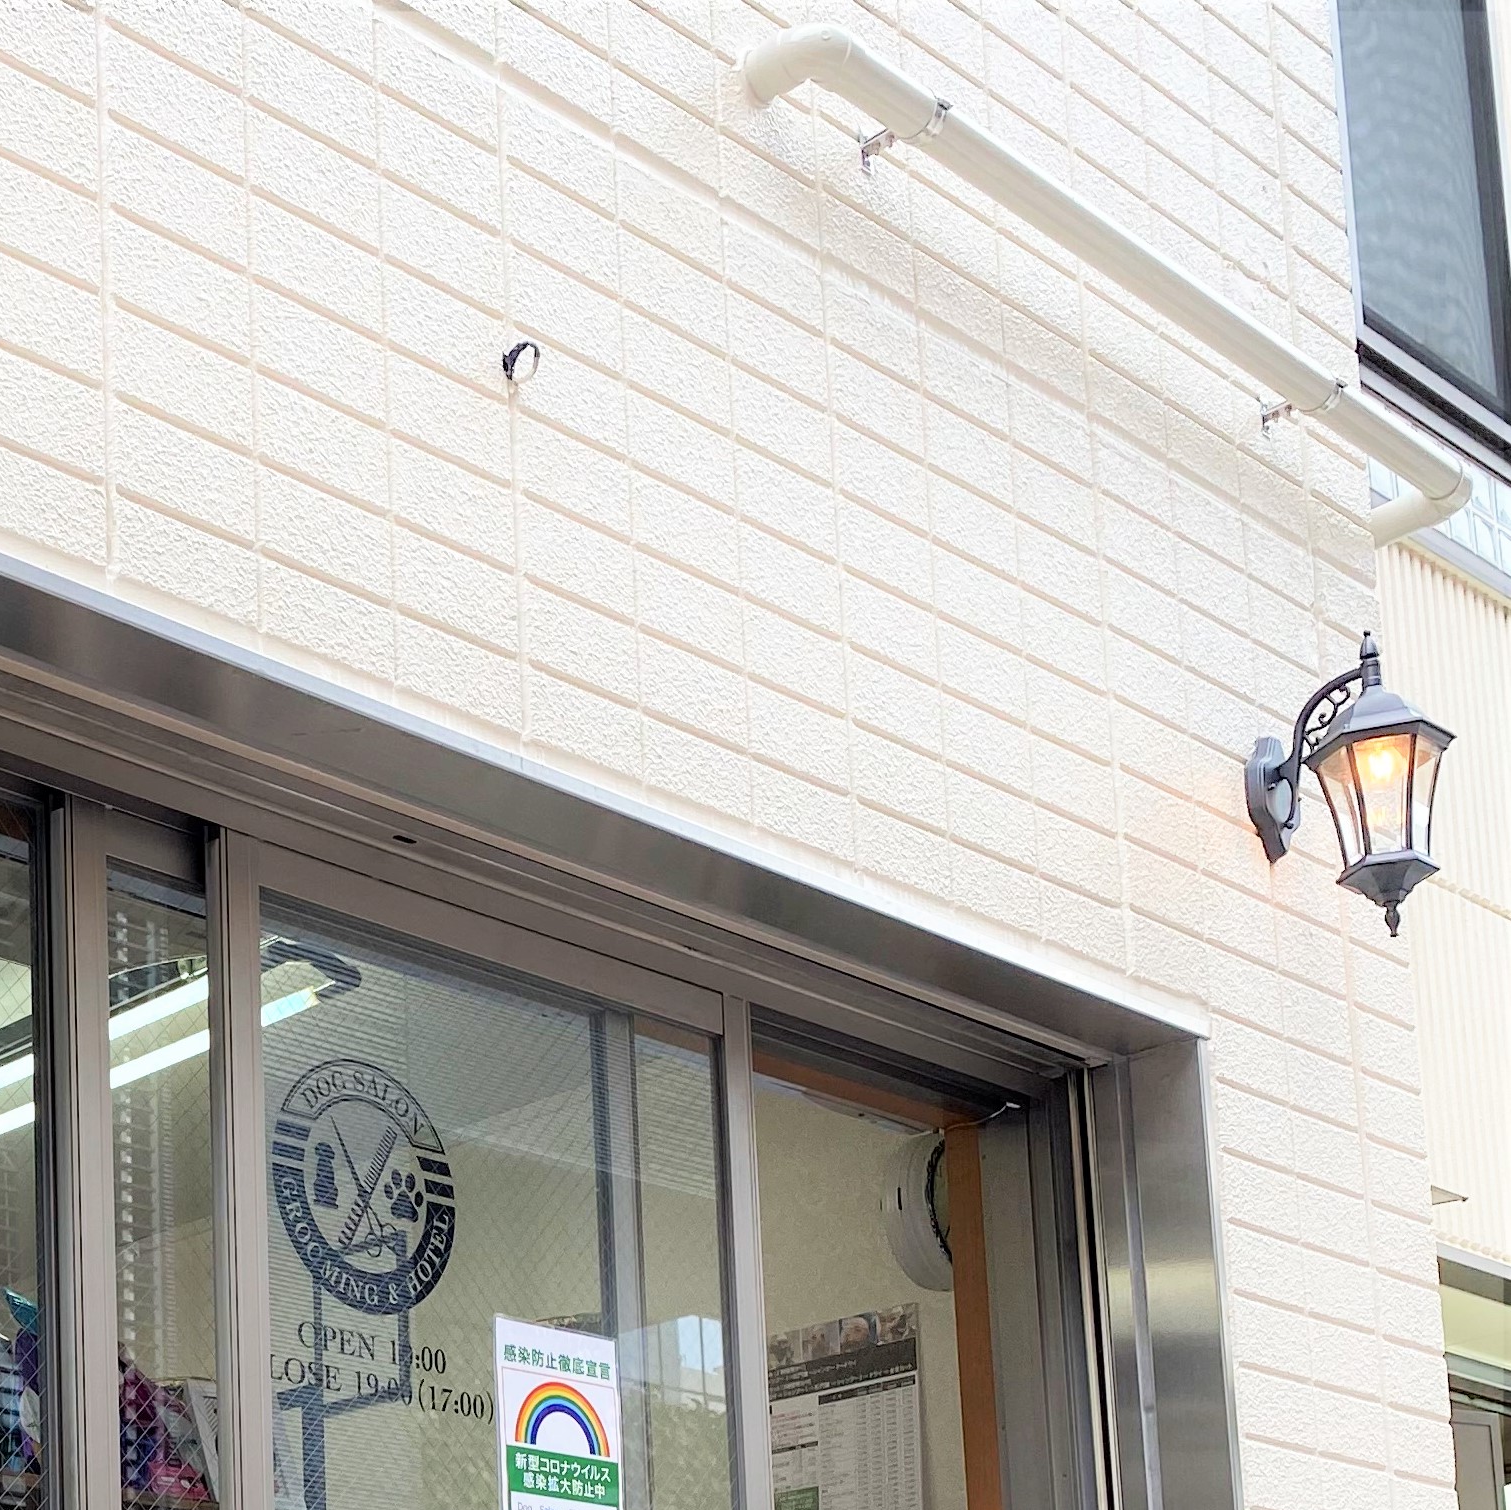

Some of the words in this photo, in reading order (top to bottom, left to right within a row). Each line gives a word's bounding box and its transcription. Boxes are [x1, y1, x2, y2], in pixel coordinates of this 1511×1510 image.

[299, 1072, 347, 1109] DOG
[353, 1070, 425, 1135] SALON
[280, 1177, 379, 1305] GROOMING
[389, 1282, 399, 1304] &
[406, 1213, 449, 1299] HOTEL
[297, 1321, 376, 1361] OPEN
[503, 1344, 611, 1380] 感染防止徹底宣言
[515, 1452, 611, 1482] 新型コロナウイルス
[523, 1472, 606, 1500] 感染拡大防止中
